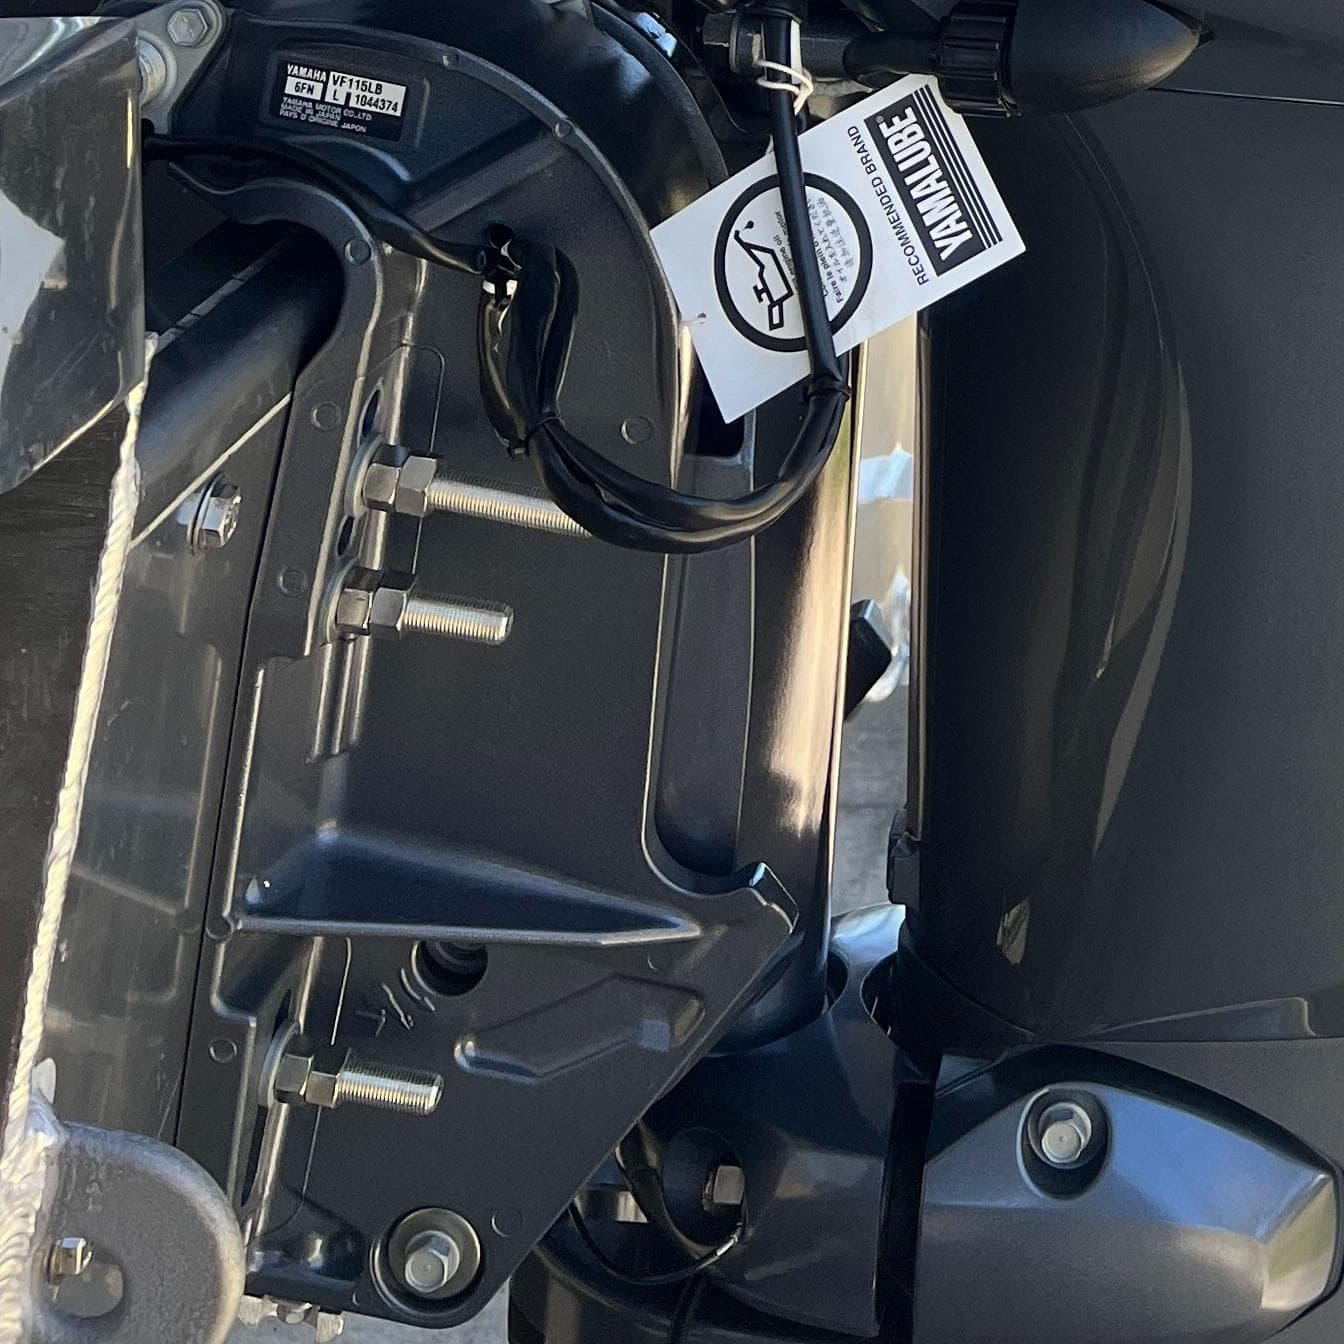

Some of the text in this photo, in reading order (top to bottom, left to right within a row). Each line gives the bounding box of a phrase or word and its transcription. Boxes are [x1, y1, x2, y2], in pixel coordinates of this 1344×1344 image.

[286, 63, 328, 82] YAMAHA
[331, 73, 383, 95] VF115LB
[332, 88, 398, 113] L 1044374
[340, 121, 366, 133] JAPON
[878, 105, 975, 261] YAMALUBE
[846, 123, 929, 287] RECOMMENDED BRAND
[772, 234, 782, 247] oil
[814, 246, 831, 271] plein
[824, 269, 833, 280] le
[829, 279, 844, 303] Faire
